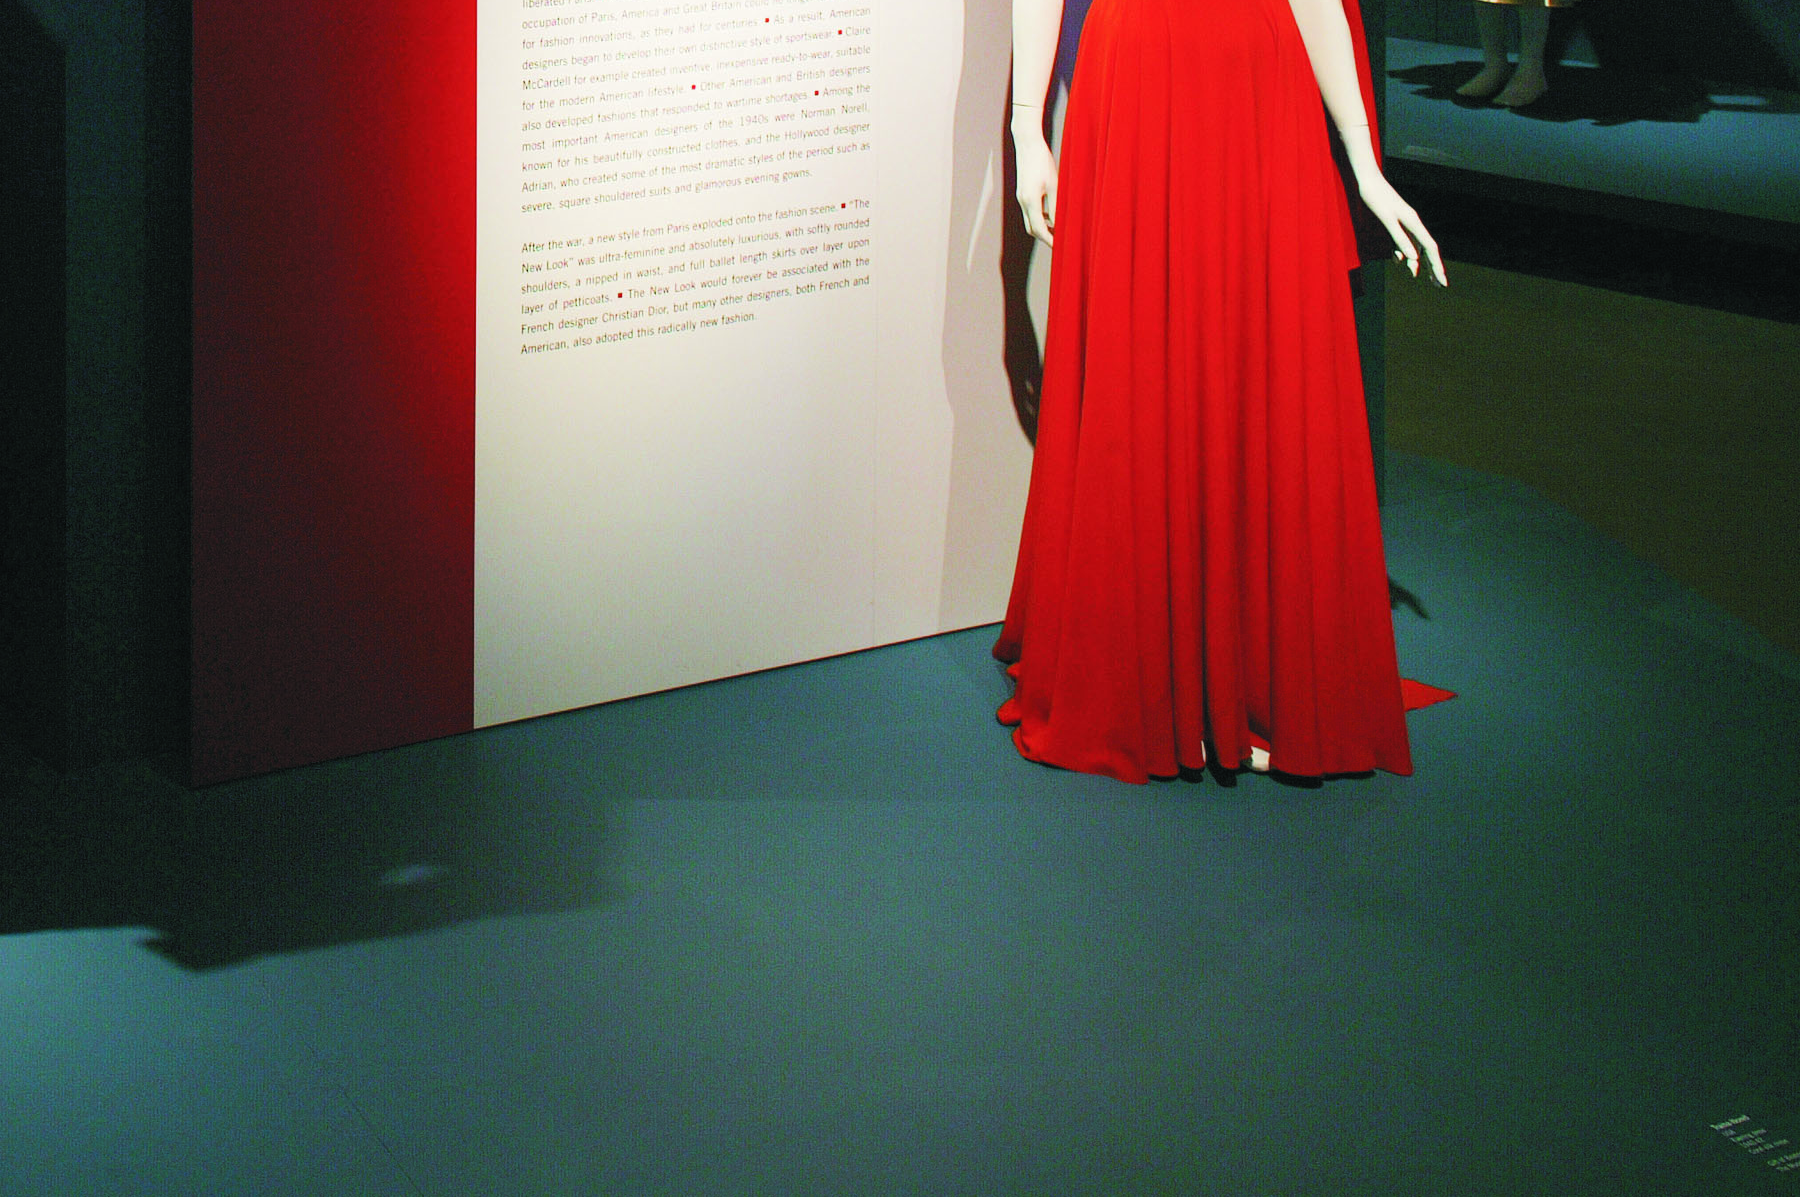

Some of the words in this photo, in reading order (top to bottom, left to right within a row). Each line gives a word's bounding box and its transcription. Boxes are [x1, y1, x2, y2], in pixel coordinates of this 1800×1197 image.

[520, 241, 544, 252] After
[547, 238, 563, 249] the
[588, 236, 594, 244] a
[596, 233, 615, 243] new
[618, 227, 640, 241] style
[642, 226, 664, 237] from
[666, 221, 690, 233] Paris
[692, 214, 733, 231] exploded
[735, 214, 756, 224] onto
[757, 210, 772, 222] the
[774, 206, 808, 219] fashion
[520, 263, 542, 273] New
[577, 256, 595, 265] was
[668, 241, 686, 253] and
[688, 235, 735, 251] absolutely
[784, 225, 804, 238] with
[806, 222, 830, 235] softly
[833, 216, 870, 231] rounded
[520, 303, 544, 315] layer
[548, 298, 558, 310] of
[628, 287, 644, 298] The
[649, 285, 670, 295] New
[674, 279, 696, 292] Look
[700, 274, 727, 288] would
[731, 273, 762, 284] forever
[766, 268, 778, 279] be
[781, 260, 828, 277] associated
[832, 257, 851, 270] with
[855, 255, 870, 267] the
[575, 278, 581, 286] a
[585, 270, 618, 286] nipped
[622, 268, 632, 279] in
[668, 260, 686, 273] and
[689, 258, 705, 270] full
[709, 255, 735, 267] ballet
[739, 249, 768, 264] length
[771, 247, 796, 259] skirts
[799, 245, 818, 255] over
[822, 241, 843, 254] layer
[847, 238, 870, 250] upon
[520, 318, 554, 333] French
[558, 315, 598, 328] designer
[601, 307, 644, 322] Christian
[672, 301, 688, 312] but
[691, 298, 716, 309] many
[719, 293, 743, 305] other
[795, 281, 816, 294] both
[818, 276, 850, 291] French
[852, 273, 870, 286] and
[572, 335, 592, 347] also
[595, 328, 634, 344] adopted
[636, 325, 654, 338] this
[657, 319, 696, 335] radically
[699, 319, 718, 328] new
